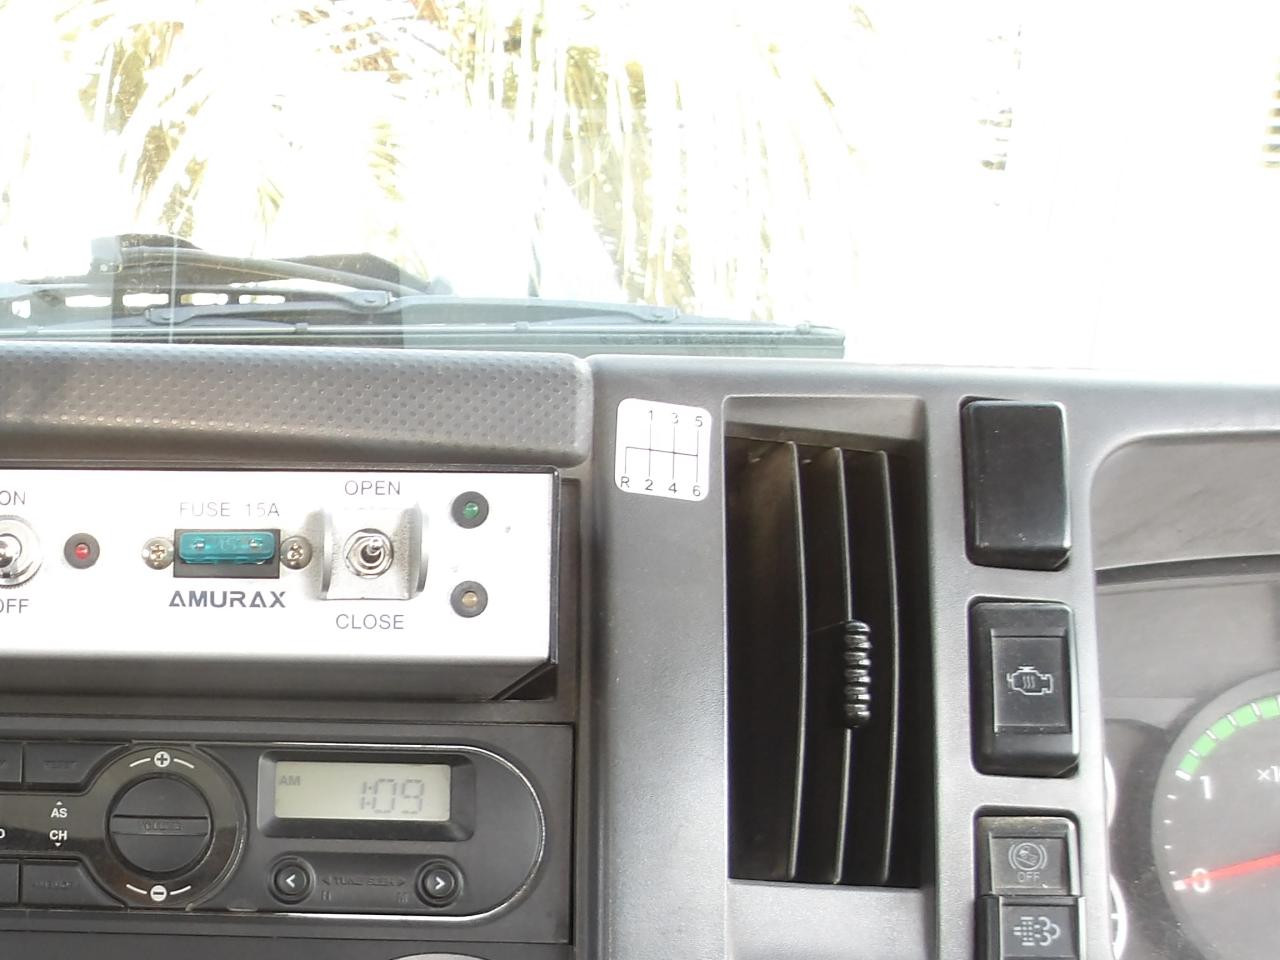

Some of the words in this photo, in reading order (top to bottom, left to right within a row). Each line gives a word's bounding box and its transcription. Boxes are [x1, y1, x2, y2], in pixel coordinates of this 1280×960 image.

[671, 412, 680, 425] 3
[695, 415, 704, 428] 5
[344, 480, 402, 496] OPEN
[620, 475, 631, 489] R
[644, 478, 654, 492] 2
[667, 482, 678, 495] 4
[692, 485, 702, 498] 6
[179, 502, 232, 518] FUSE
[246, 502, 281, 518] 15A
[168, 590, 287, 608] AMURAX
[335, 613, 406, 631] CLOSE
[279, 775, 301, 786] AM
[1200, 775, 1212, 800] 1
[360, 778, 425, 814] 1:09
[50, 808, 68, 818] AS
[49, 830, 68, 841] CH
[1017, 871, 1040, 882] OFF
